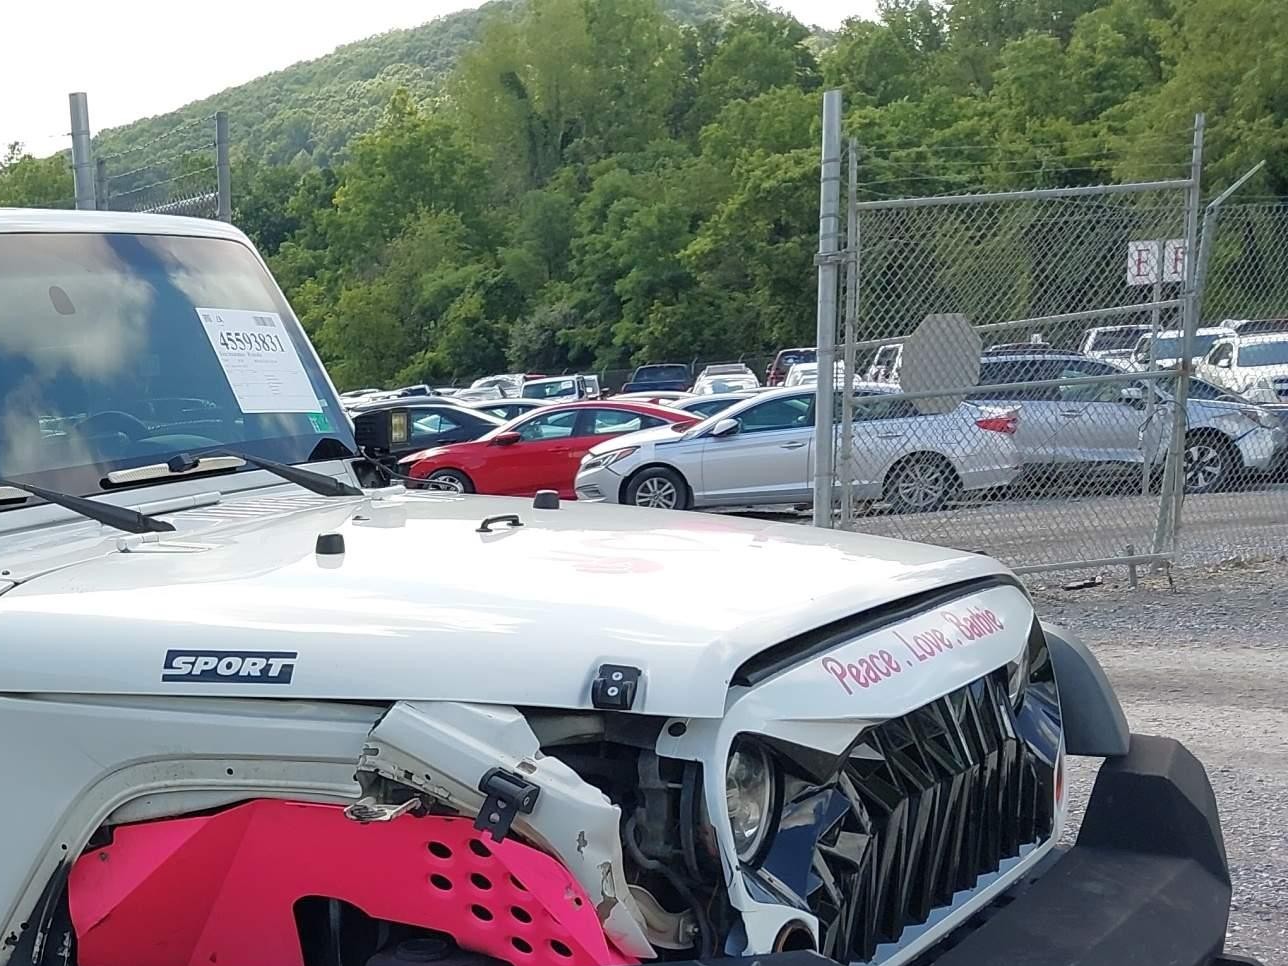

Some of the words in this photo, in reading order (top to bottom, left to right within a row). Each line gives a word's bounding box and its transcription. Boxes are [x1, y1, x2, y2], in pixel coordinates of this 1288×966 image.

[1135, 248, 1150, 277] E
[219, 331, 285, 352] 45593831
[940, 604, 1005, 641] Barbie
[162, 655, 297, 678] SPORT
